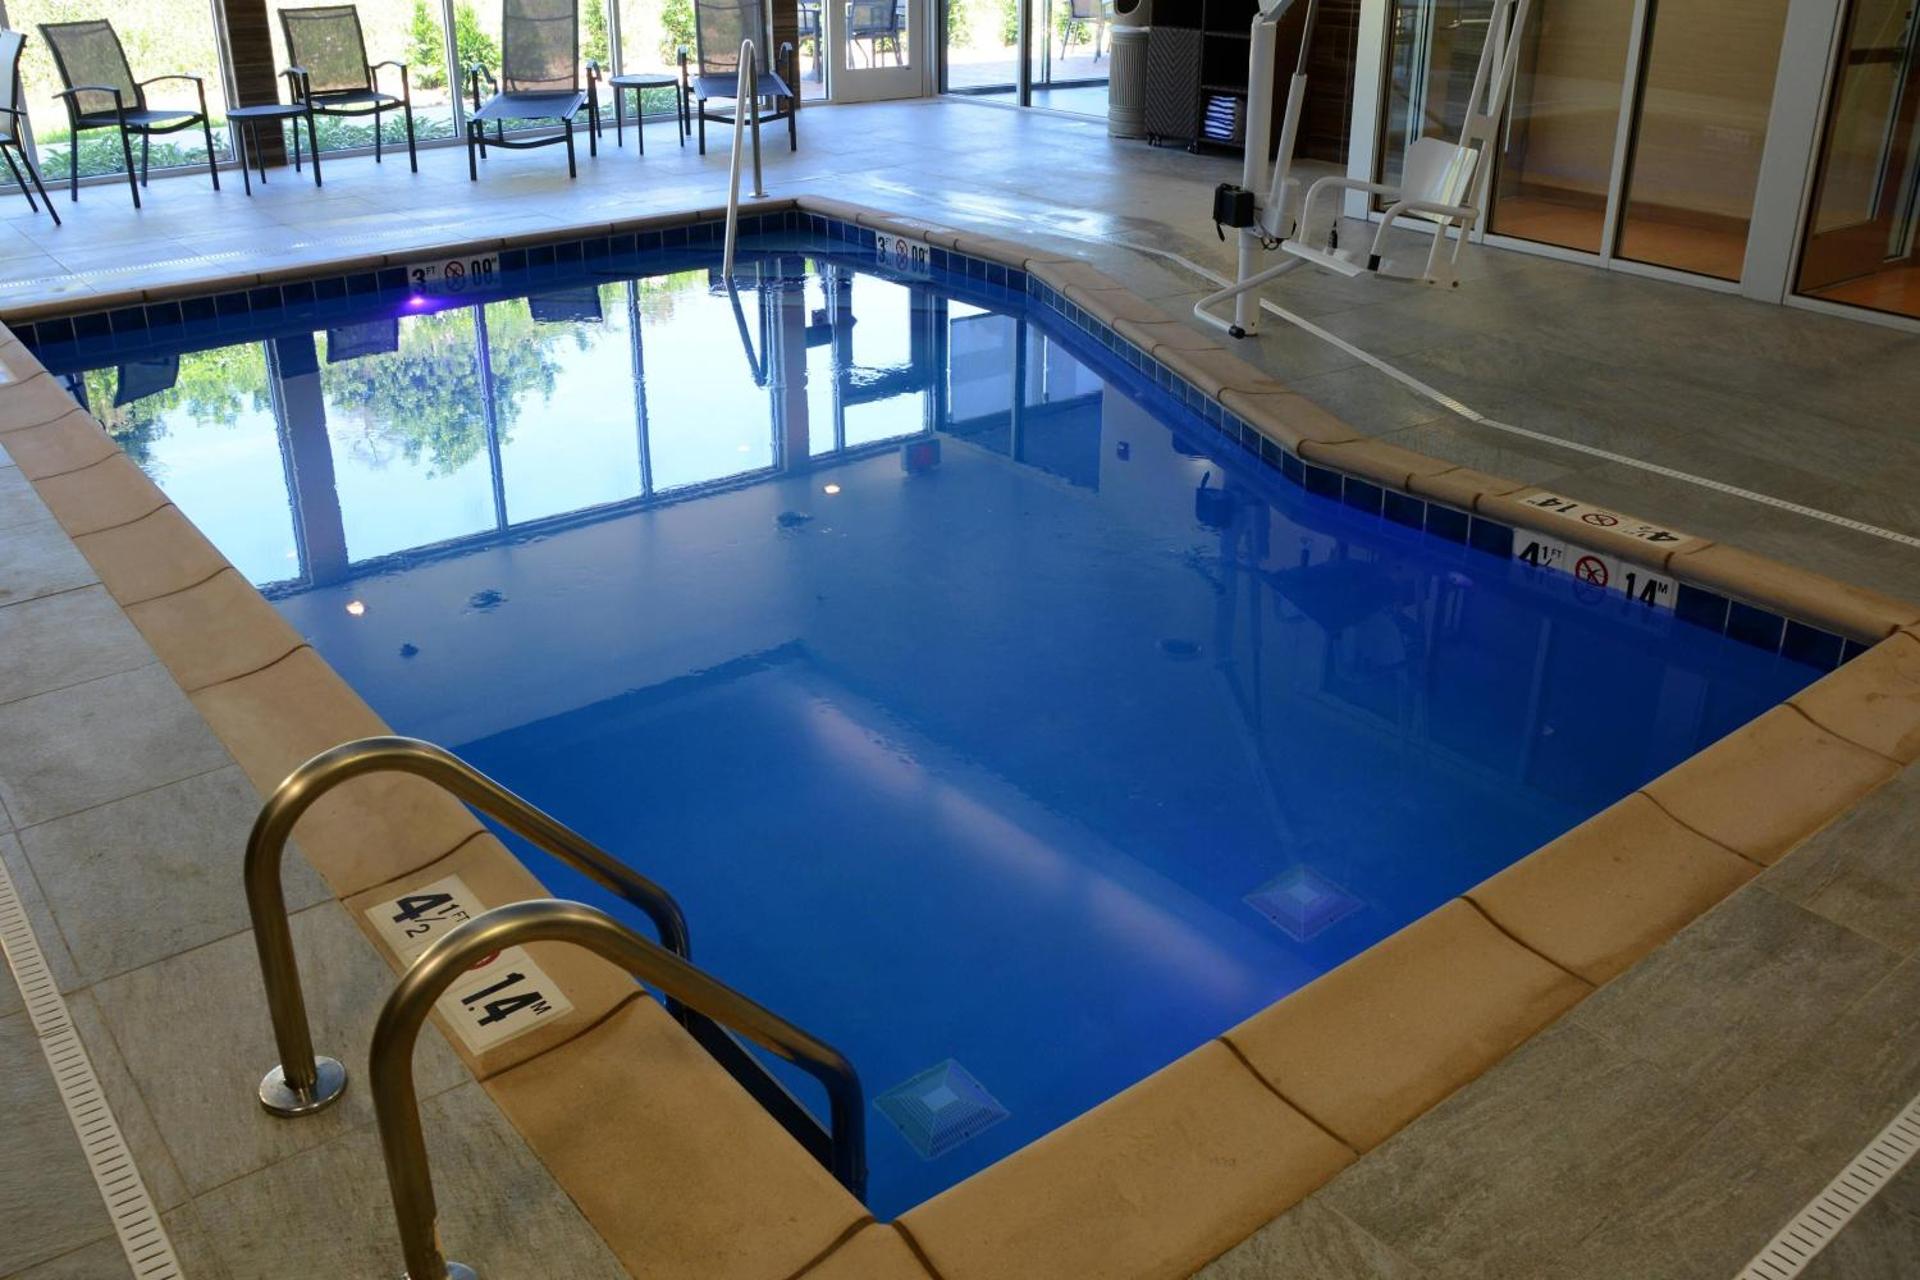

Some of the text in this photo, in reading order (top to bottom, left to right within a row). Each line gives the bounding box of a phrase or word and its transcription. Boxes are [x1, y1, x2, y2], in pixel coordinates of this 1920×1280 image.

[412, 269, 426, 284] 3
[461, 972, 543, 1027] 1.4
[530, 1000, 552, 1015] M
